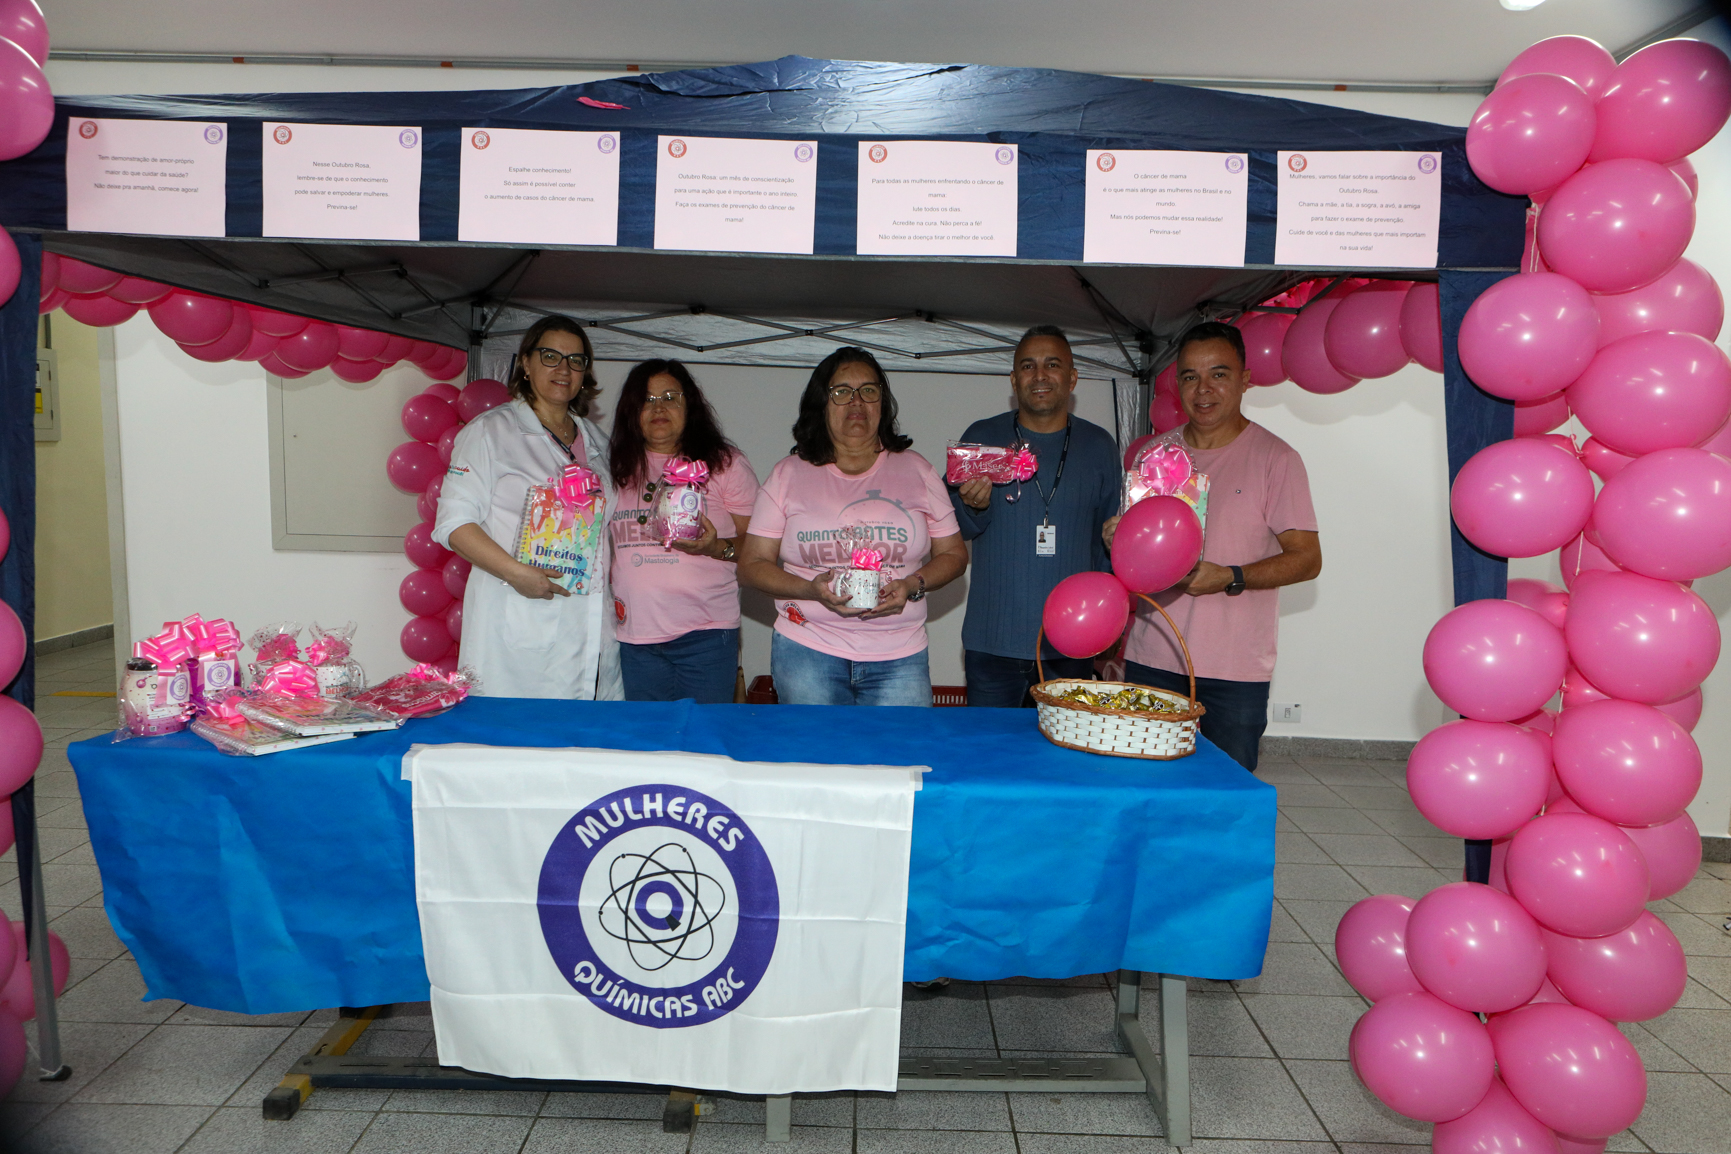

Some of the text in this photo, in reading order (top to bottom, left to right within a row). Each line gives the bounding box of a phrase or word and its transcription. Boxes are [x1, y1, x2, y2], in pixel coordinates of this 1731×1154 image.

[111, 154, 150, 164] demonstração
[354, 161, 371, 169] Rosa,
[508, 166, 531, 174] Espalhe
[751, 175, 795, 184] conscientização
[1375, 173, 1407, 181] importância
[534, 180, 558, 188] possível
[181, 185, 199, 194] agora!
[294, 188, 309, 196] pode
[332, 189, 362, 198] empoderar
[701, 187, 715, 196] ação
[733, 188, 762, 197] importante
[1140, 186, 1158, 194] atinge
[675, 200, 690, 209] Faça
[729, 202, 759, 211] prevenção
[1403, 202, 1421, 210] amiga
[1135, 213, 1161, 222] podemos
[912, 233, 933, 242] doença
[1400, 230, 1426, 239] importam
[853, 526, 908, 543] ANTES
[535, 545, 583, 562] Direitos
[798, 542, 907, 565] MELOR
[574, 792, 745, 853] MULHERES
[572, 959, 746, 1018] QUÍMICAS ABC
